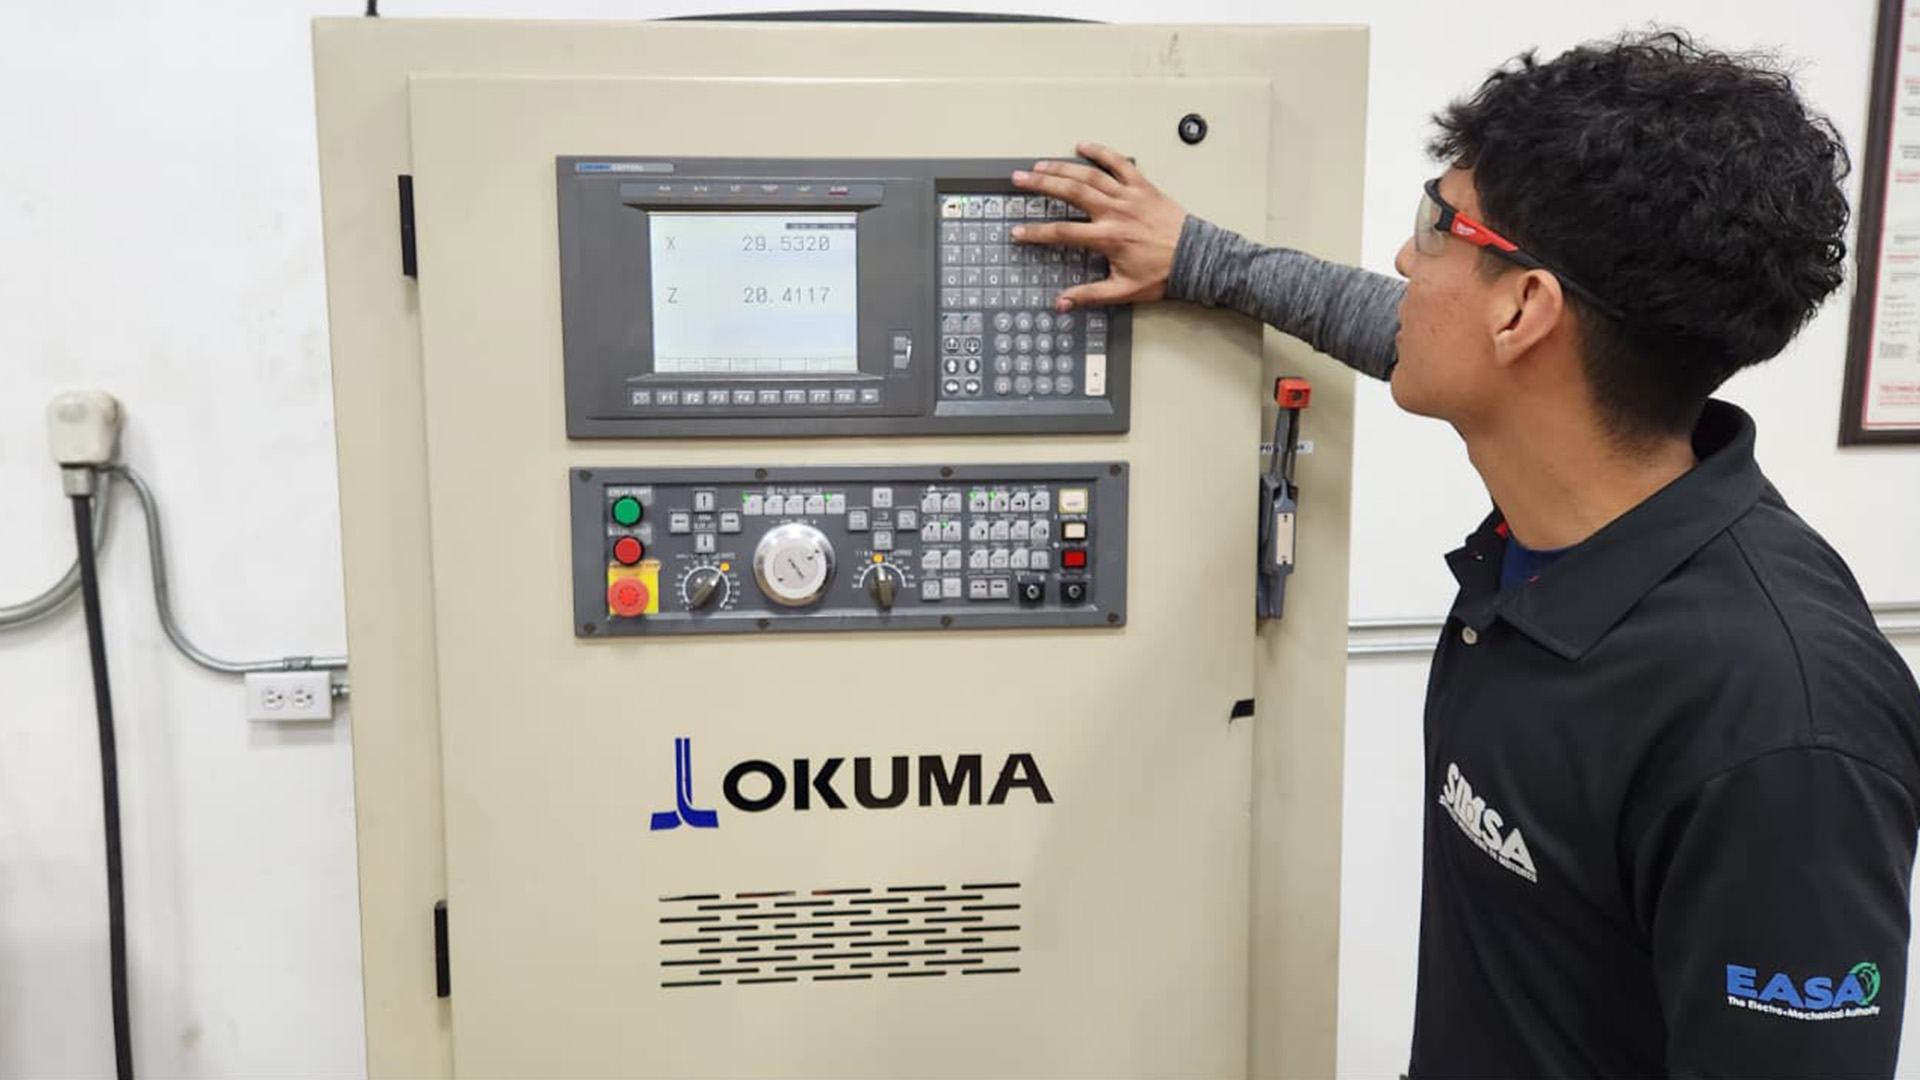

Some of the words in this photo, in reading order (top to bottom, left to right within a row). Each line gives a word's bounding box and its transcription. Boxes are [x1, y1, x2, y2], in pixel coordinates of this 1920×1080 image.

[666, 237, 676, 250] X
[667, 287, 678, 303] Z
[722, 752, 1055, 813] OKUMA
[1443, 762, 1537, 874] SIMSA
[1726, 963, 1865, 1010] EASA
[1728, 996, 1746, 1008] The
